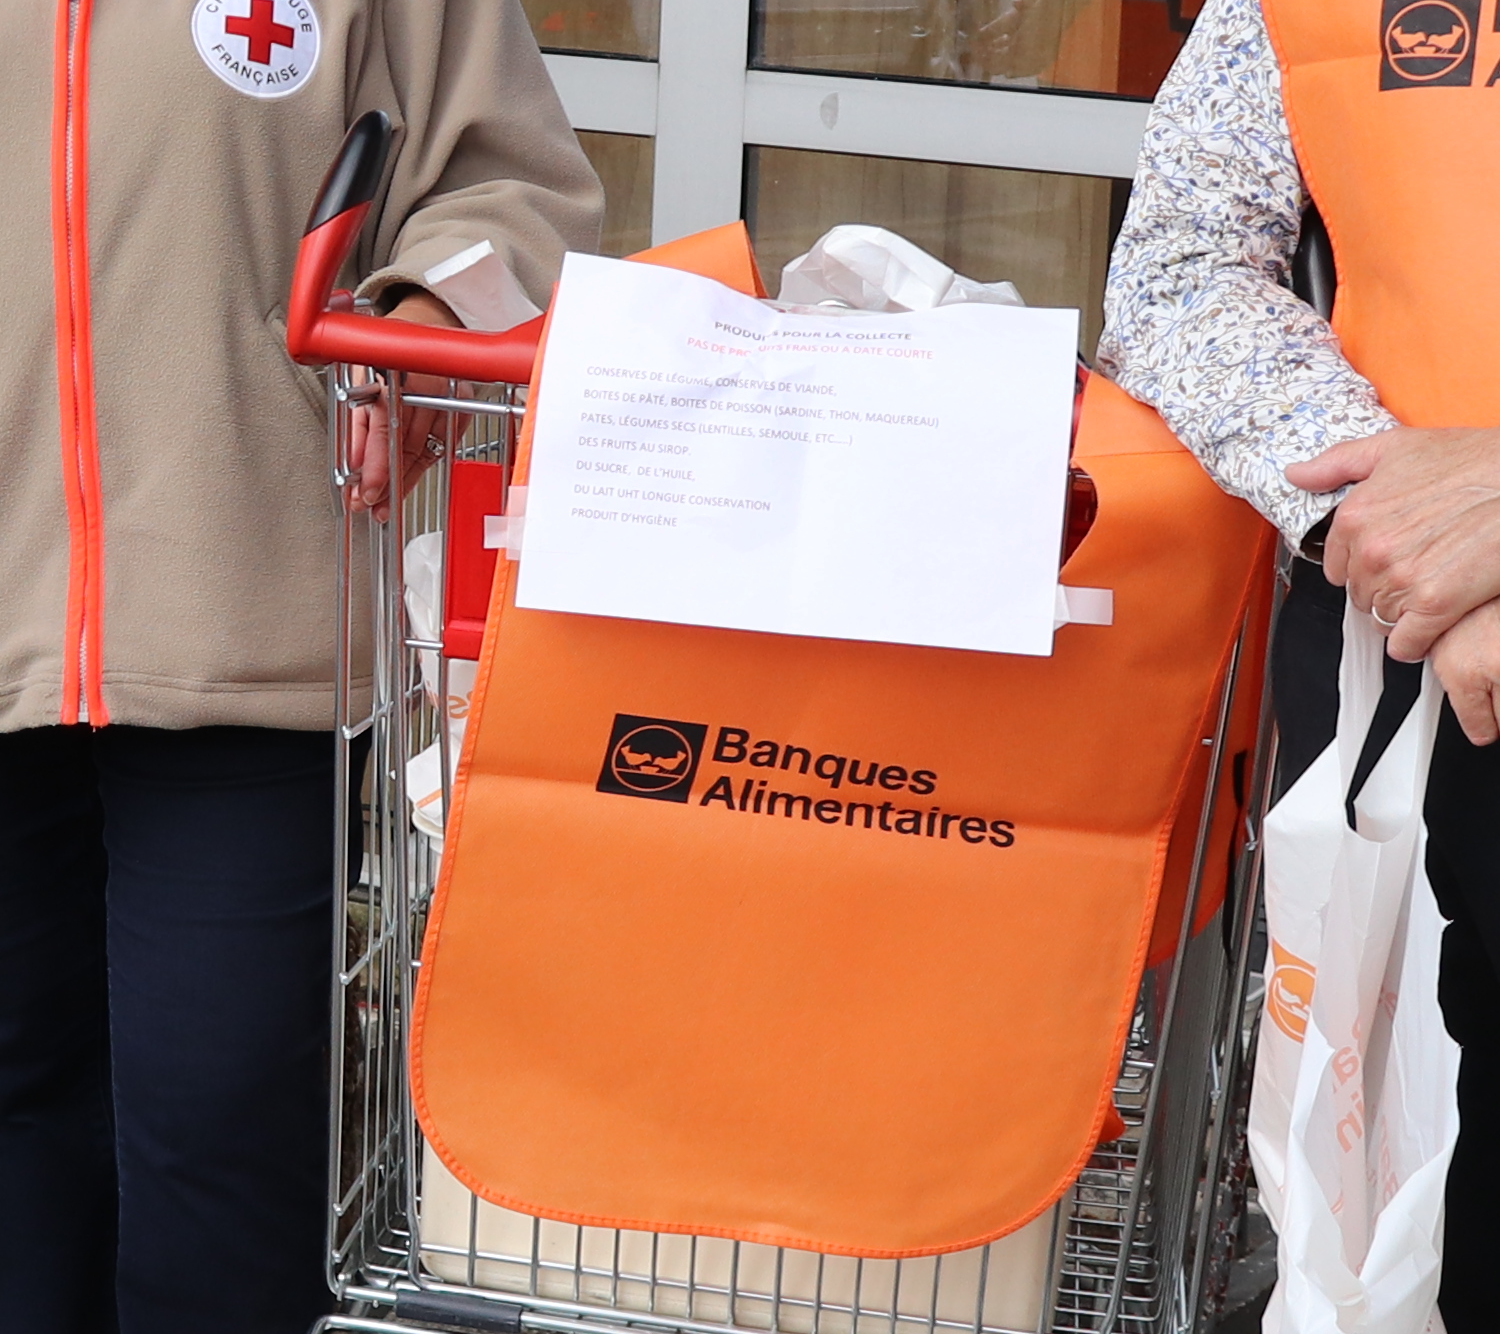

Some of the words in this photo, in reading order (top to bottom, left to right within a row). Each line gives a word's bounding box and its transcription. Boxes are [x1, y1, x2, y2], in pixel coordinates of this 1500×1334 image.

[211, 43, 300, 86] FRANÇAISE
[687, 336, 710, 350] PAS
[711, 343, 727, 355] DE
[786, 344, 818, 352] FRAIS
[821, 345, 839, 353] OU
[853, 346, 883, 356] DATE
[886, 348, 934, 360] COURTE
[845, 332, 912, 341] COLLECTE
[586, 365, 647, 380] CONSERVES
[649, 370, 664, 381] DE
[714, 376, 776, 391] CONSERVES
[777, 381, 792, 393] DE
[795, 383, 838, 396] VIANDE,
[583, 389, 620, 402] BOITES
[622, 392, 637, 403] DE
[670, 397, 708, 410] BOITES
[710, 400, 724, 411] DE
[726, 401, 772, 415] POISSON
[774, 405, 827, 421] (SARDINE,
[829, 409, 864, 423] THON,
[865, 412, 940, 429] MAQUEREAU)
[580, 412, 616, 426] PATES,
[618, 414, 669, 430] LÉGUMES
[671, 421, 696, 433] SECS
[698, 421, 756, 438] (LENTILLES,
[758, 428, 812, 443] SEMOULE,
[578, 435, 599, 447] DES
[601, 438, 637, 451] FRUITS
[639, 442, 655, 453] AU
[657, 443, 692, 456] SIROP.
[576, 459, 592, 471] DU
[594, 462, 632, 476] SUCRE,
[637, 466, 652, 476] DE
[573, 483, 590, 495] DU
[592, 485, 614, 497] LAIT
[617, 487, 641, 500] UHT
[642, 490, 686, 504] LONGUE
[688, 494, 772, 511] CONSERVATION
[571, 507, 618, 522] PRODUIT
[620, 510, 679, 527] D'HYGIÈNE
[712, 726, 939, 796] Banques
[699, 776, 1017, 848] Alimentaires
